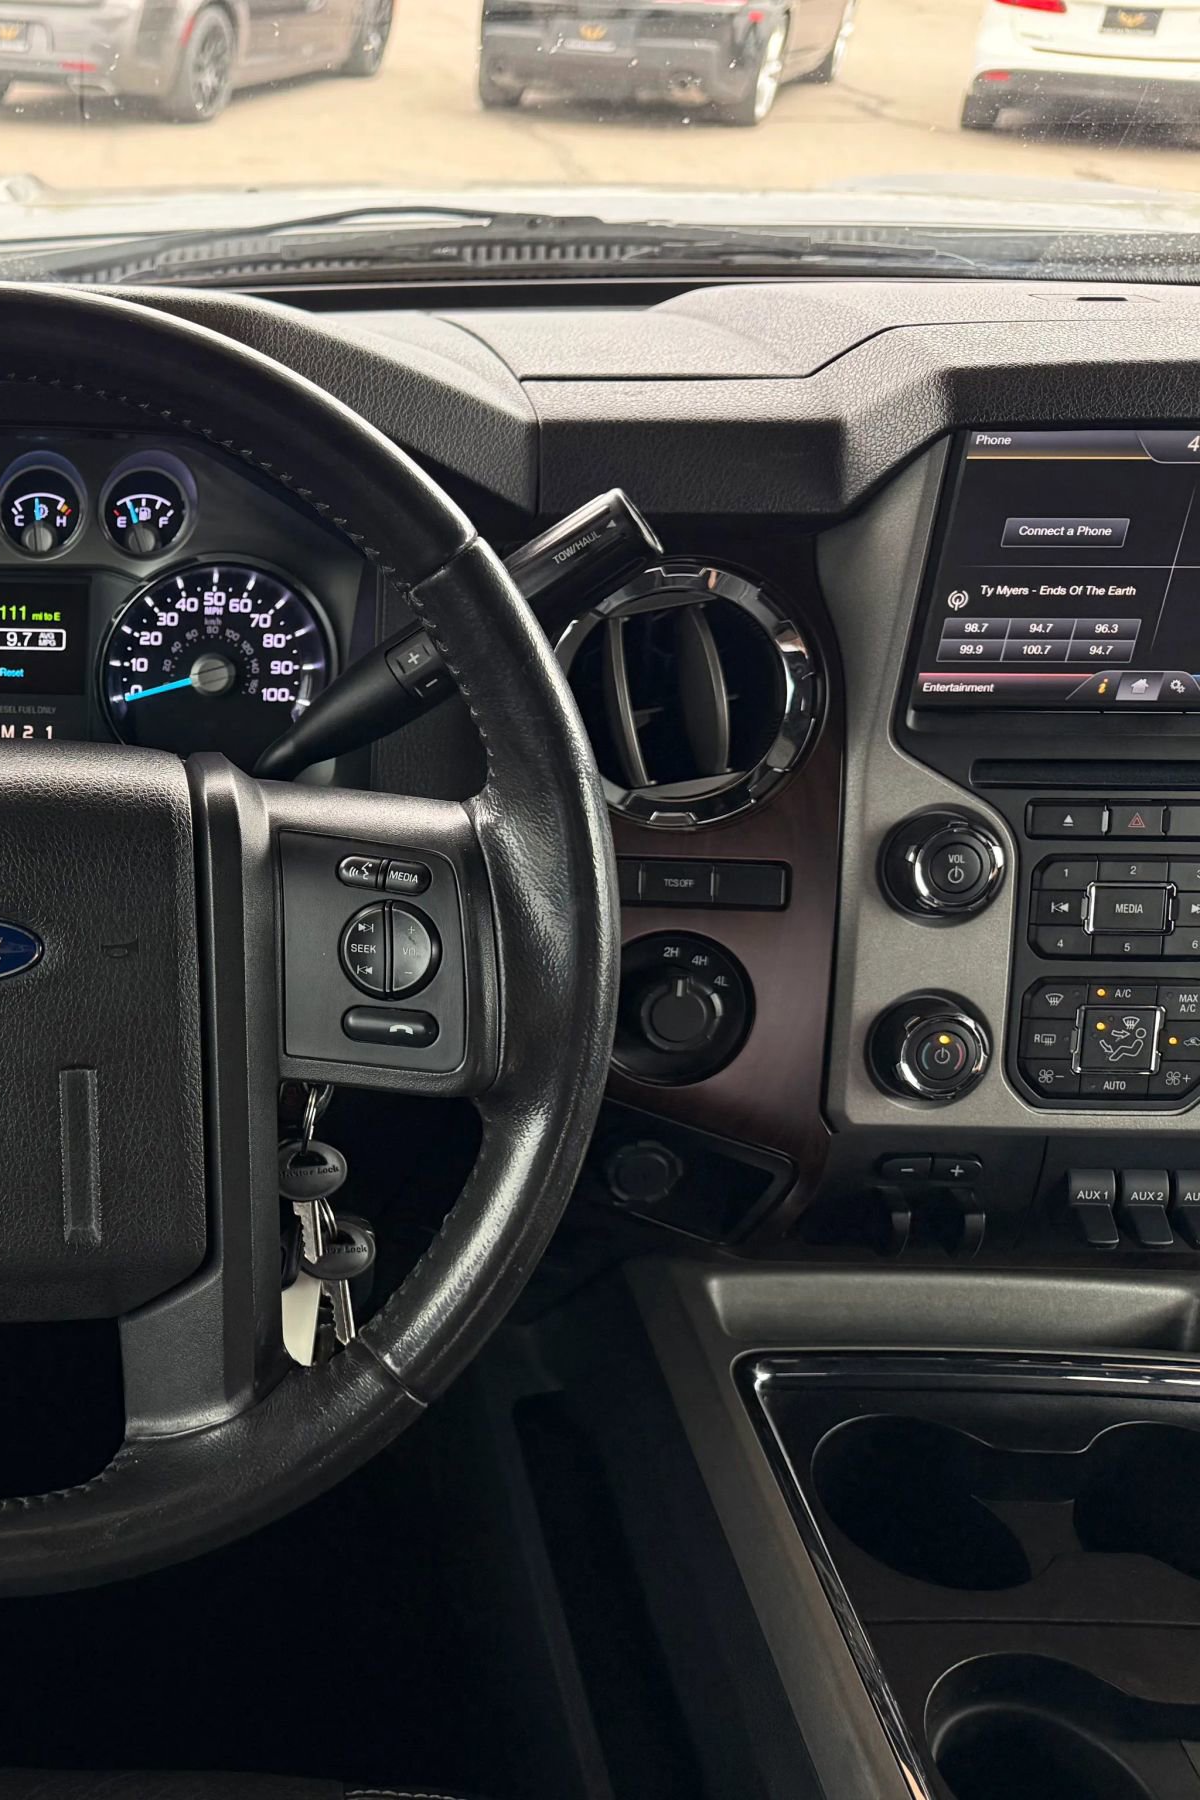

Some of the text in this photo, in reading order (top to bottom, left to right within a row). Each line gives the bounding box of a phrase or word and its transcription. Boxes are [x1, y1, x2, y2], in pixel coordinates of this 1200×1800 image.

[975, 435, 1012, 445] Phone
[14, 515, 24, 526] C
[56, 516, 67, 527] H
[117, 517, 127, 527] E
[159, 517, 169, 528] F
[1018, 526, 1112, 536] Connect a Phone
[552, 530, 602, 564] TOW/HAUL
[980, 585, 993, 596] Ty
[996, 585, 1029, 596] Myers
[1039, 585, 1066, 596] Ends
[1070, 585, 1084, 596] Of
[1086, 585, 1106, 596] The
[1108, 585, 1136, 596] Earth
[203, 591, 226, 606] 50
[175, 598, 199, 612] 40
[229, 598, 252, 613] 60
[0, 605, 26, 620] 111
[53, 613, 61, 621] E
[204, 606, 223, 615] MPH
[157, 612, 179, 626] 30
[250, 613, 272, 627] 70
[964, 623, 988, 633] 98.7
[1029, 623, 1053, 633] 94.7
[1095, 623, 1119, 633] 96.3
[6, 632, 33, 646] 9.7
[139, 631, 162, 645] 20
[262, 634, 286, 648] 80
[959, 645, 983, 655] 99.9
[1022, 645, 1051, 655] 100.7
[1089, 645, 1113, 655] 94.7
[130, 658, 148, 671] 10
[270, 660, 294, 674] 90
[0, 668, 25, 677] Reset
[922, 682, 994, 692] Entertainment
[261, 688, 290, 702] 100
[37, 706, 56, 714] ONLY
[1, 725, 15, 738] M
[22, 725, 34, 738] 2
[46, 725, 53, 739] 1
[948, 854, 966, 863] VOL
[1130, 866, 1137, 874] 2
[389, 870, 419, 883] MEDIA
[664, 878, 695, 887] TCS OFF
[1115, 903, 1143, 913] MEDIA
[350, 944, 377, 953] SEEK
[1057, 939, 1064, 948] 4
[1124, 943, 1131, 951] 5
[1192, 940, 1198, 948] 6
[663, 946, 679, 957] 2H
[691, 955, 708, 966] 4H
[714, 976, 729, 987] 4L
[1114, 989, 1132, 997] A/C
[1179, 994, 1199, 1002] MAX
[1179, 1004, 1197, 1012] A/C
[1103, 1080, 1126, 1090] AUTO
[317, 1165, 339, 1174] Lock
[1077, 1190, 1101, 1199] AUX
[1131, 1191, 1164, 1200] AUX 2
[1184, 1192, 1200, 1200] AU
